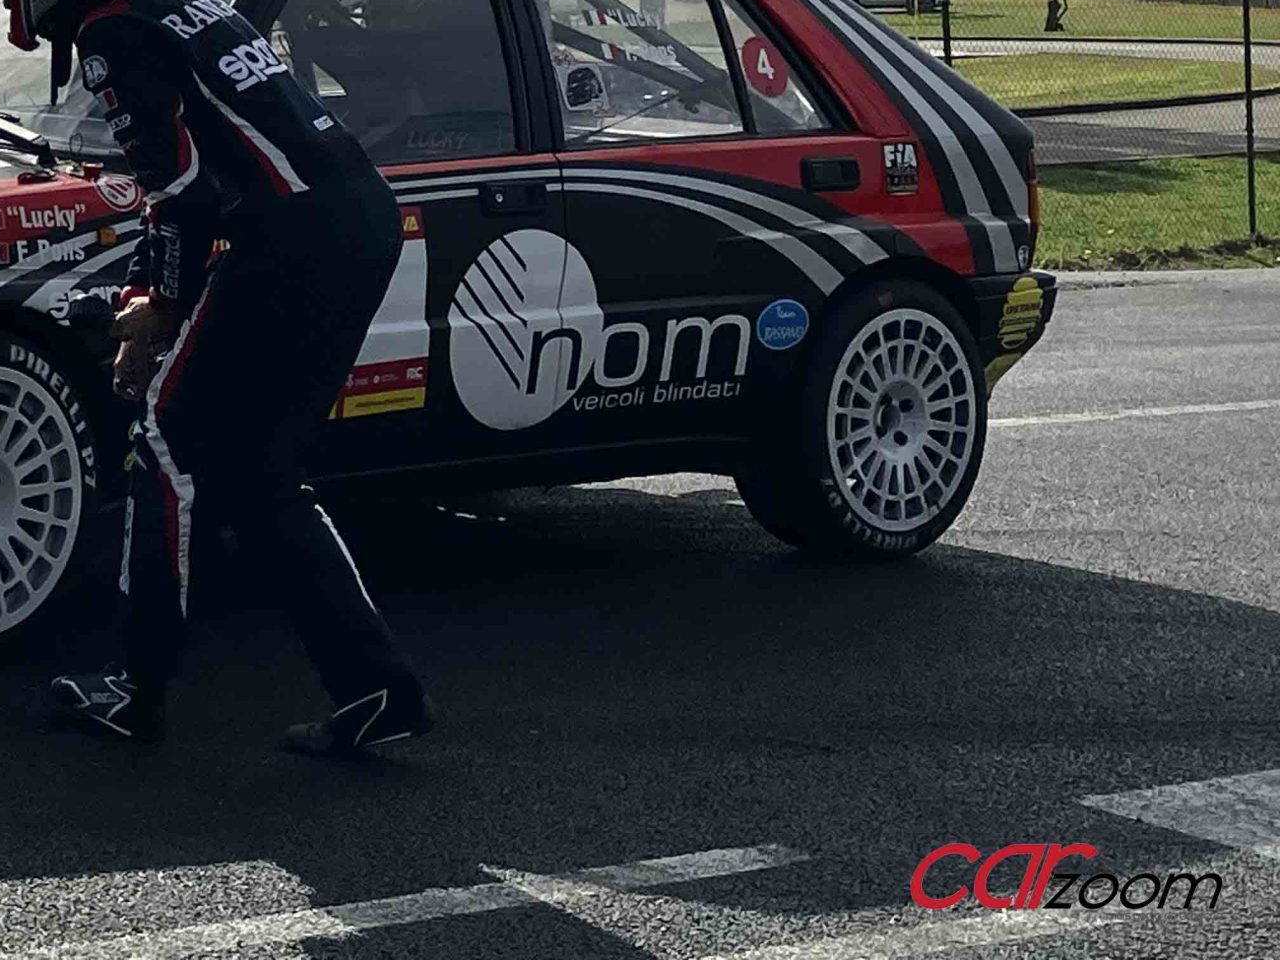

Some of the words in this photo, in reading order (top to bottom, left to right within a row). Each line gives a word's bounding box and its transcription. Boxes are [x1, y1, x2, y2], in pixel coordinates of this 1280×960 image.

[757, 48, 775, 80] 4
[527, 313, 751, 395] nom
[9, 343, 87, 436] PIRELLI
[573, 386, 645, 411] veicoli
[653, 379, 741, 403] blindati
